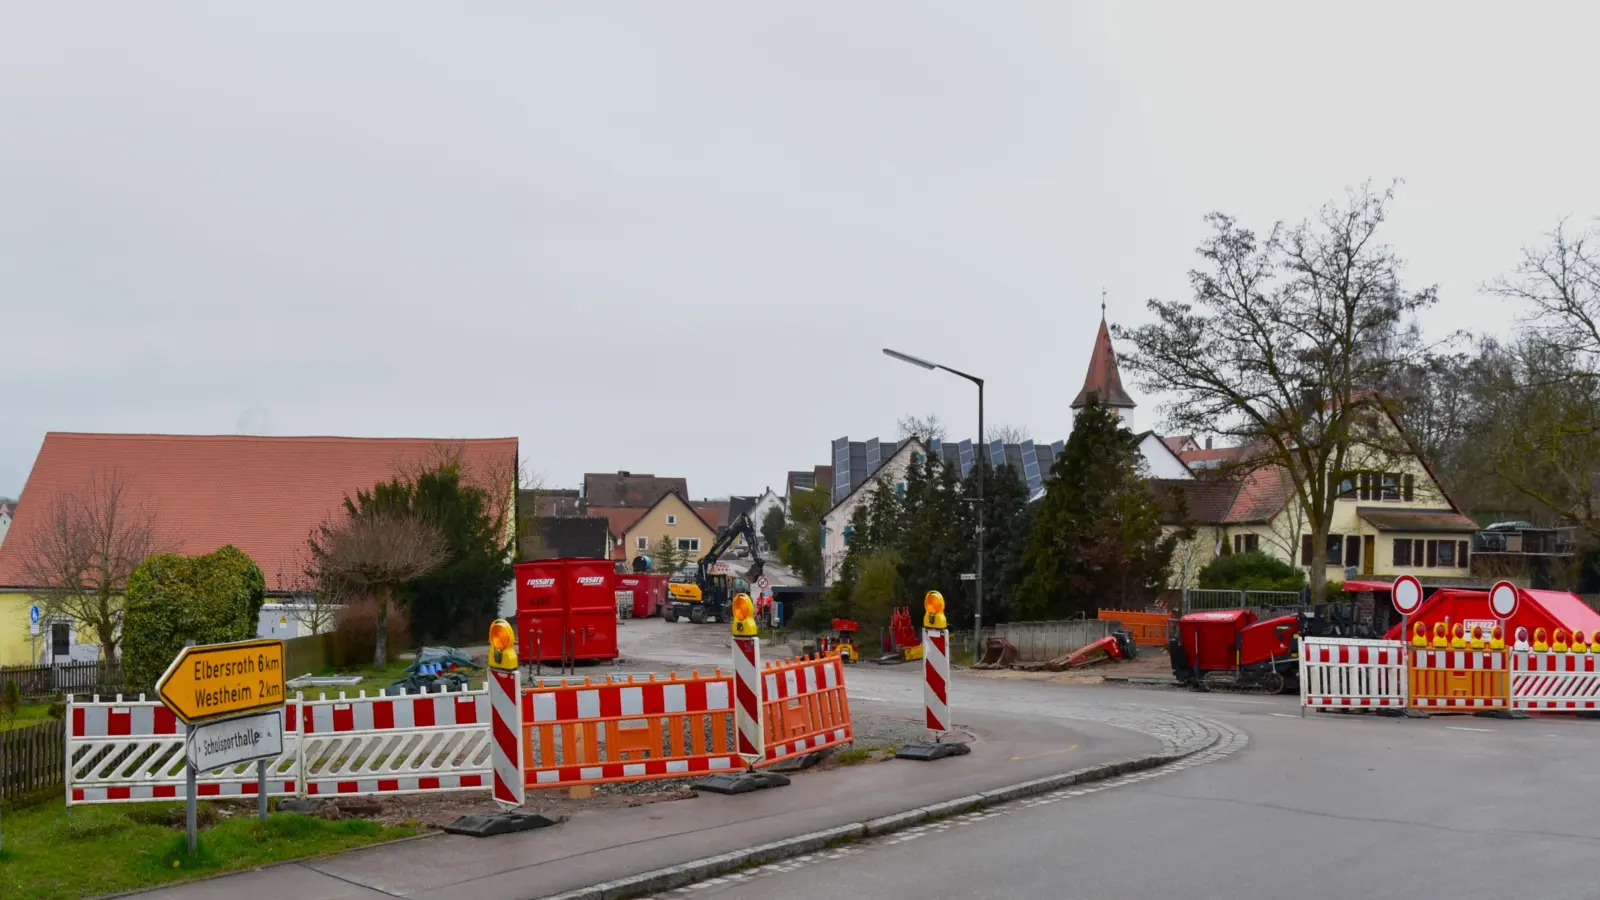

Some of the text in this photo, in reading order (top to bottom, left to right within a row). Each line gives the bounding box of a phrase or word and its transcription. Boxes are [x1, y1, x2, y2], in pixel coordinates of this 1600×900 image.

[194, 654, 279, 681] Elbersroth 6 km
[195, 680, 280, 708] Westheim 2 km
[203, 729, 260, 756] Schulsporthalle
